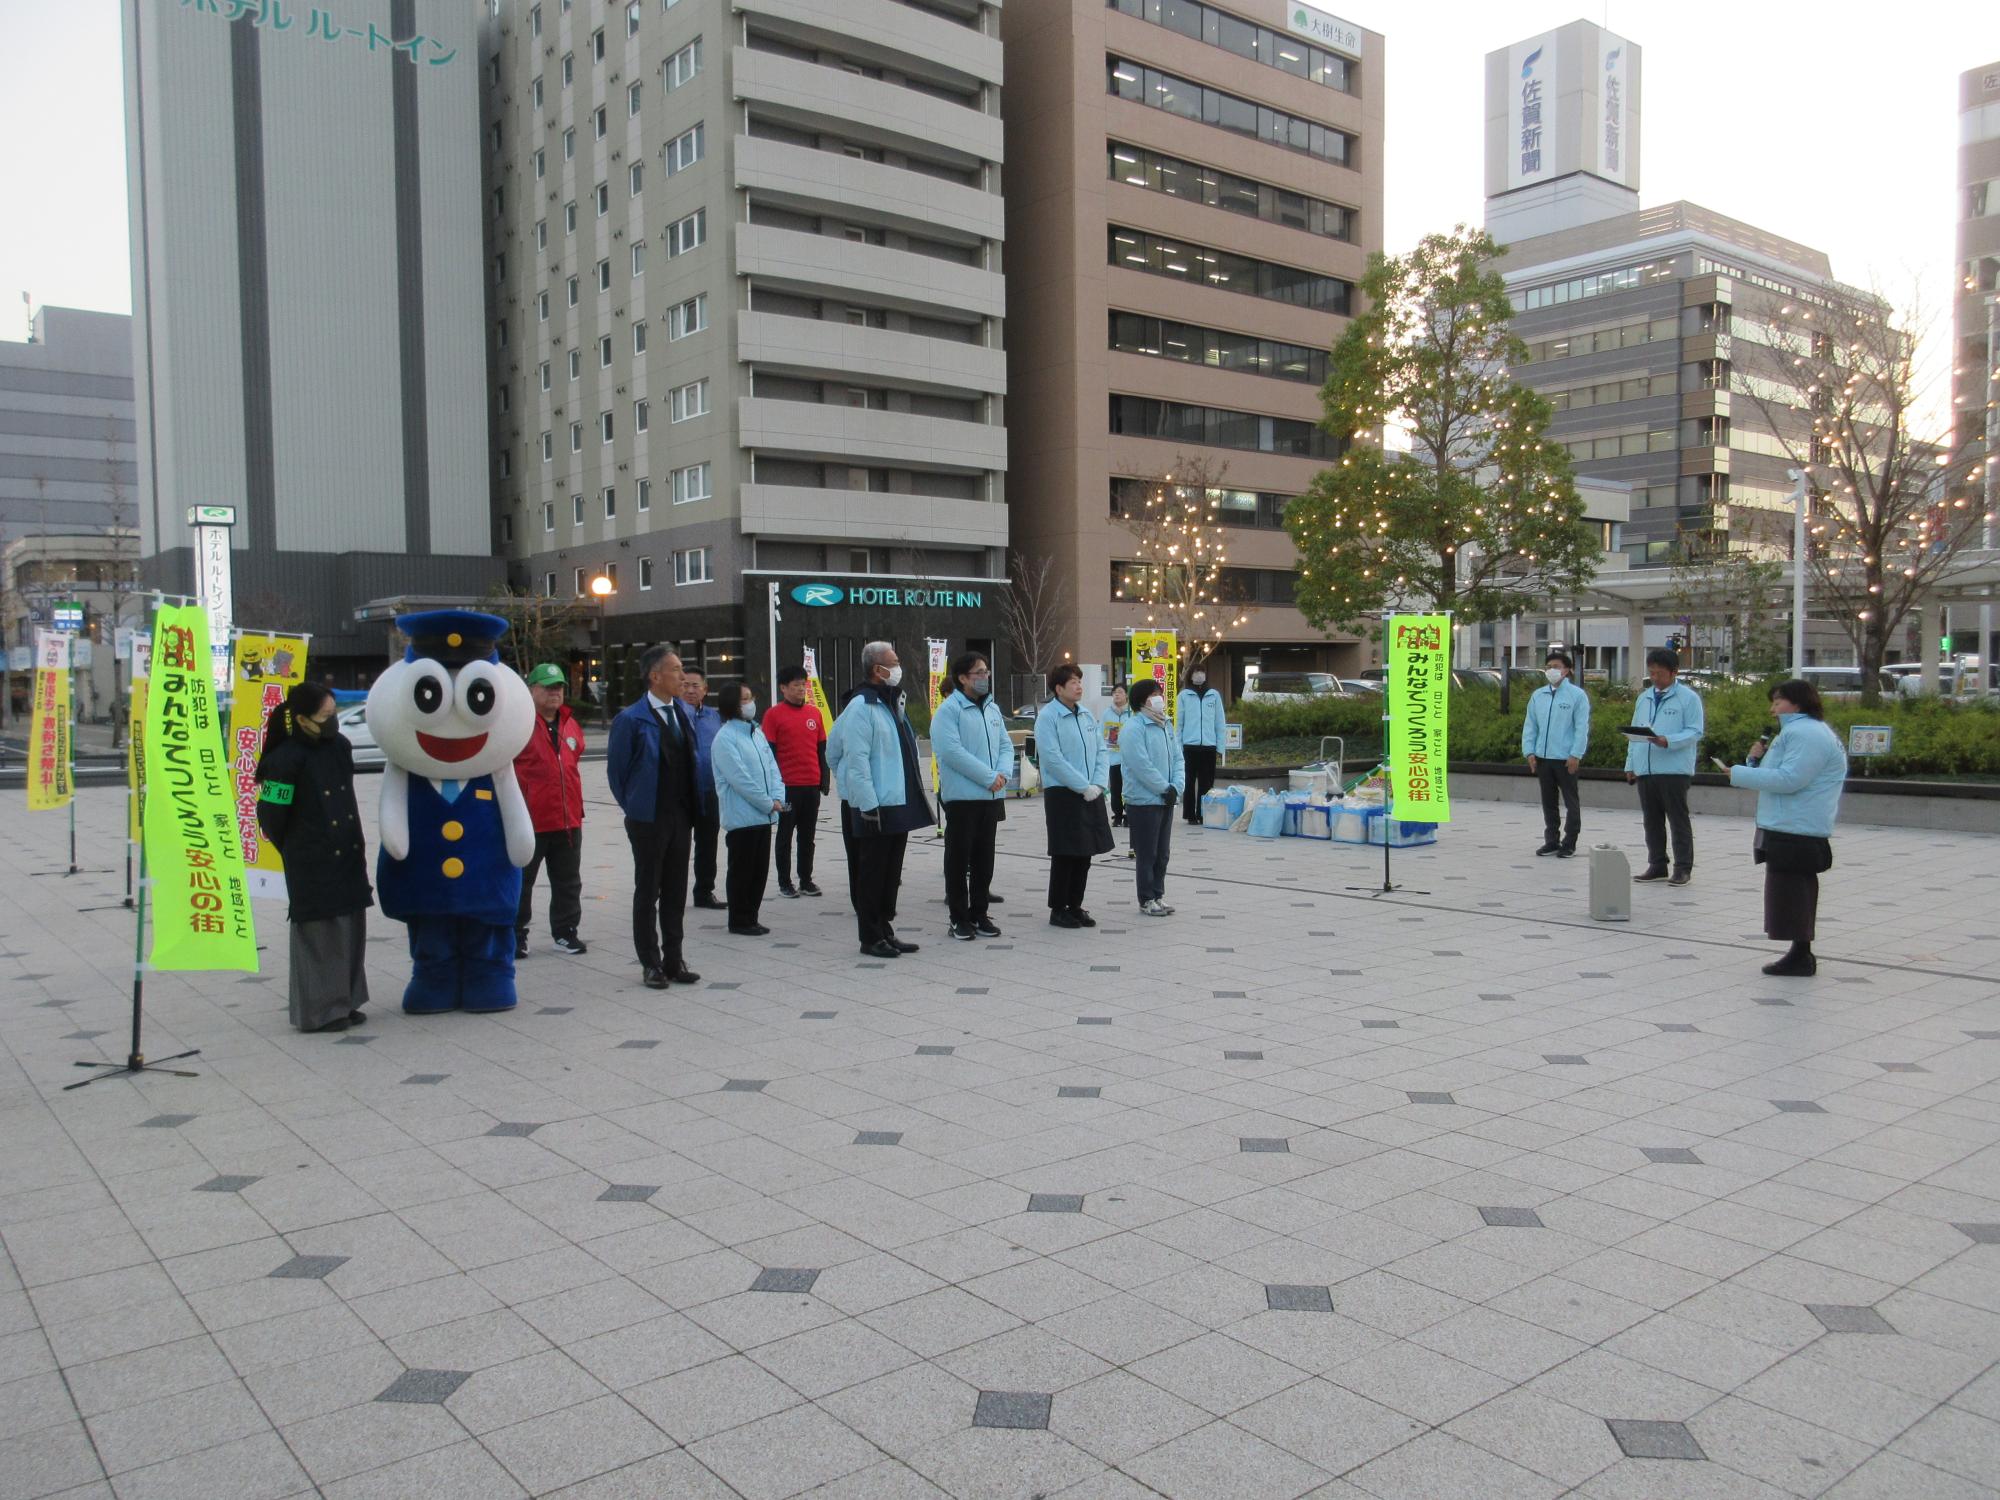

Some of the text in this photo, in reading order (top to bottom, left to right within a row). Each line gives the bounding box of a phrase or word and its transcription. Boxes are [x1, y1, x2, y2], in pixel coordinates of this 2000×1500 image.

[305, 9, 457, 65] ルートイン
[1311, 17, 1356, 48] 大樹生命
[1521, 80, 1542, 175] 佐賀新聞
[850, 587, 981, 608] HOTEL ROUTE INN
[1434, 653, 1443, 681] 防犯は
[1433, 691, 1442, 719] 日ごと
[191, 679, 209, 729] 防犯は
[200, 749, 222, 796] 日ごと
[236, 726, 258, 863] 安心安全な街
[262, 783, 289, 800] 防犯
